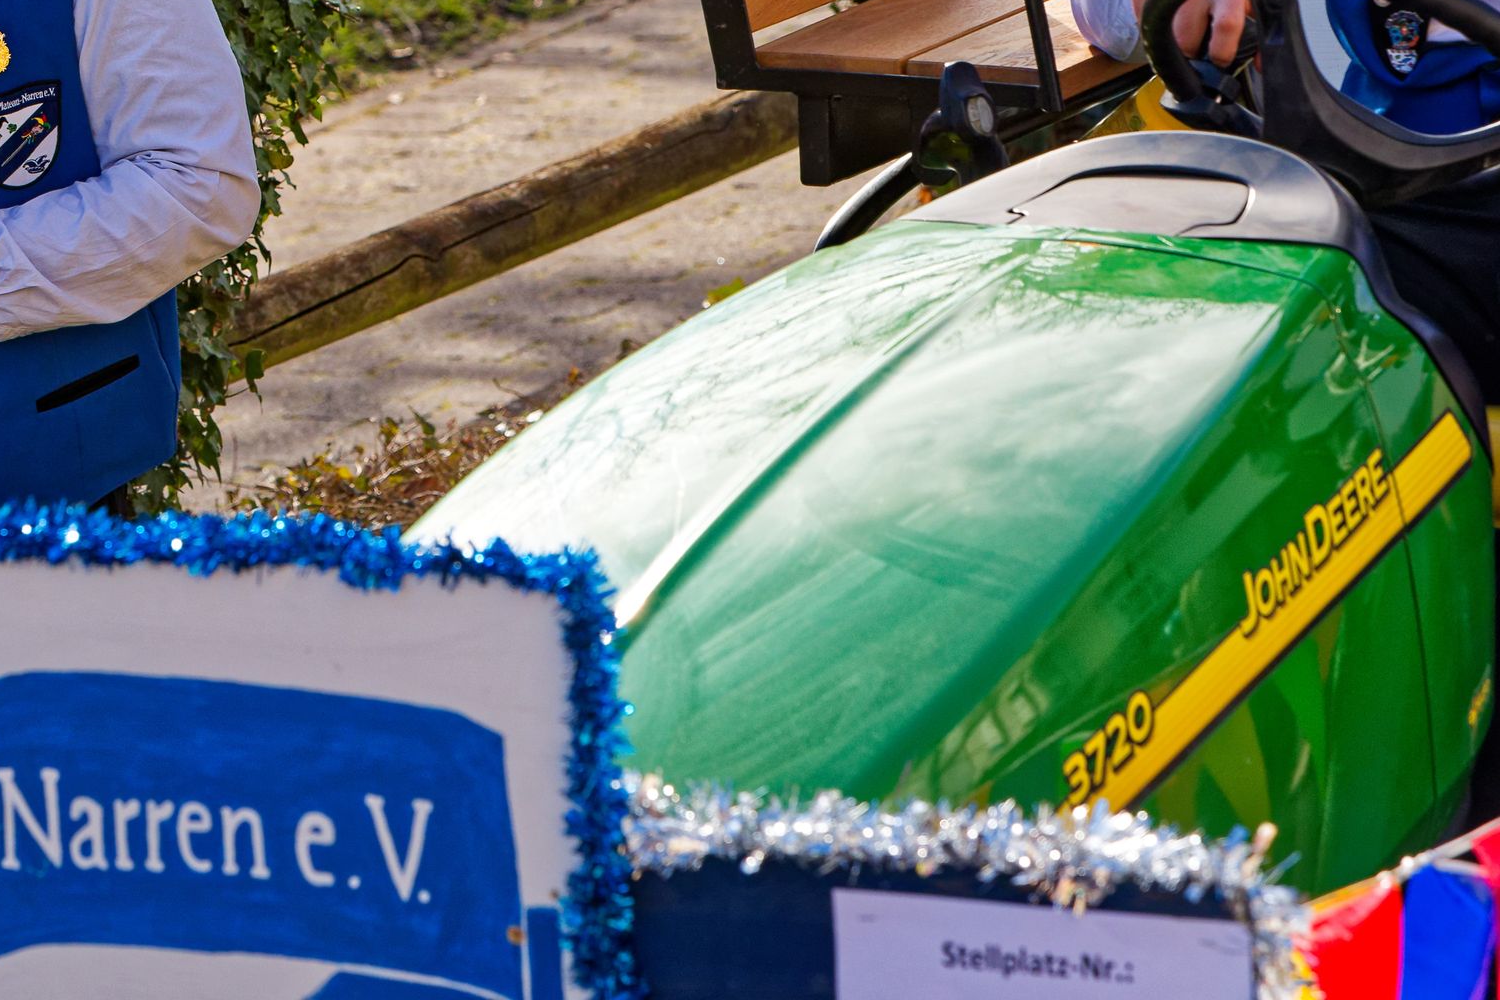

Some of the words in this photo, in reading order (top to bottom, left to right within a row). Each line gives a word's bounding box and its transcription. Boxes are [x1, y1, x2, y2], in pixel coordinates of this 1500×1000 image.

[44, 87, 56, 97] e.V.
[1240, 530, 1311, 636] JOHN
[1304, 448, 1391, 570] DEERE
[1062, 690, 1153, 804] 3720
[296, 795, 433, 904] e.V.
[941, 941, 1135, 983] Stellplatz-Nr.:
